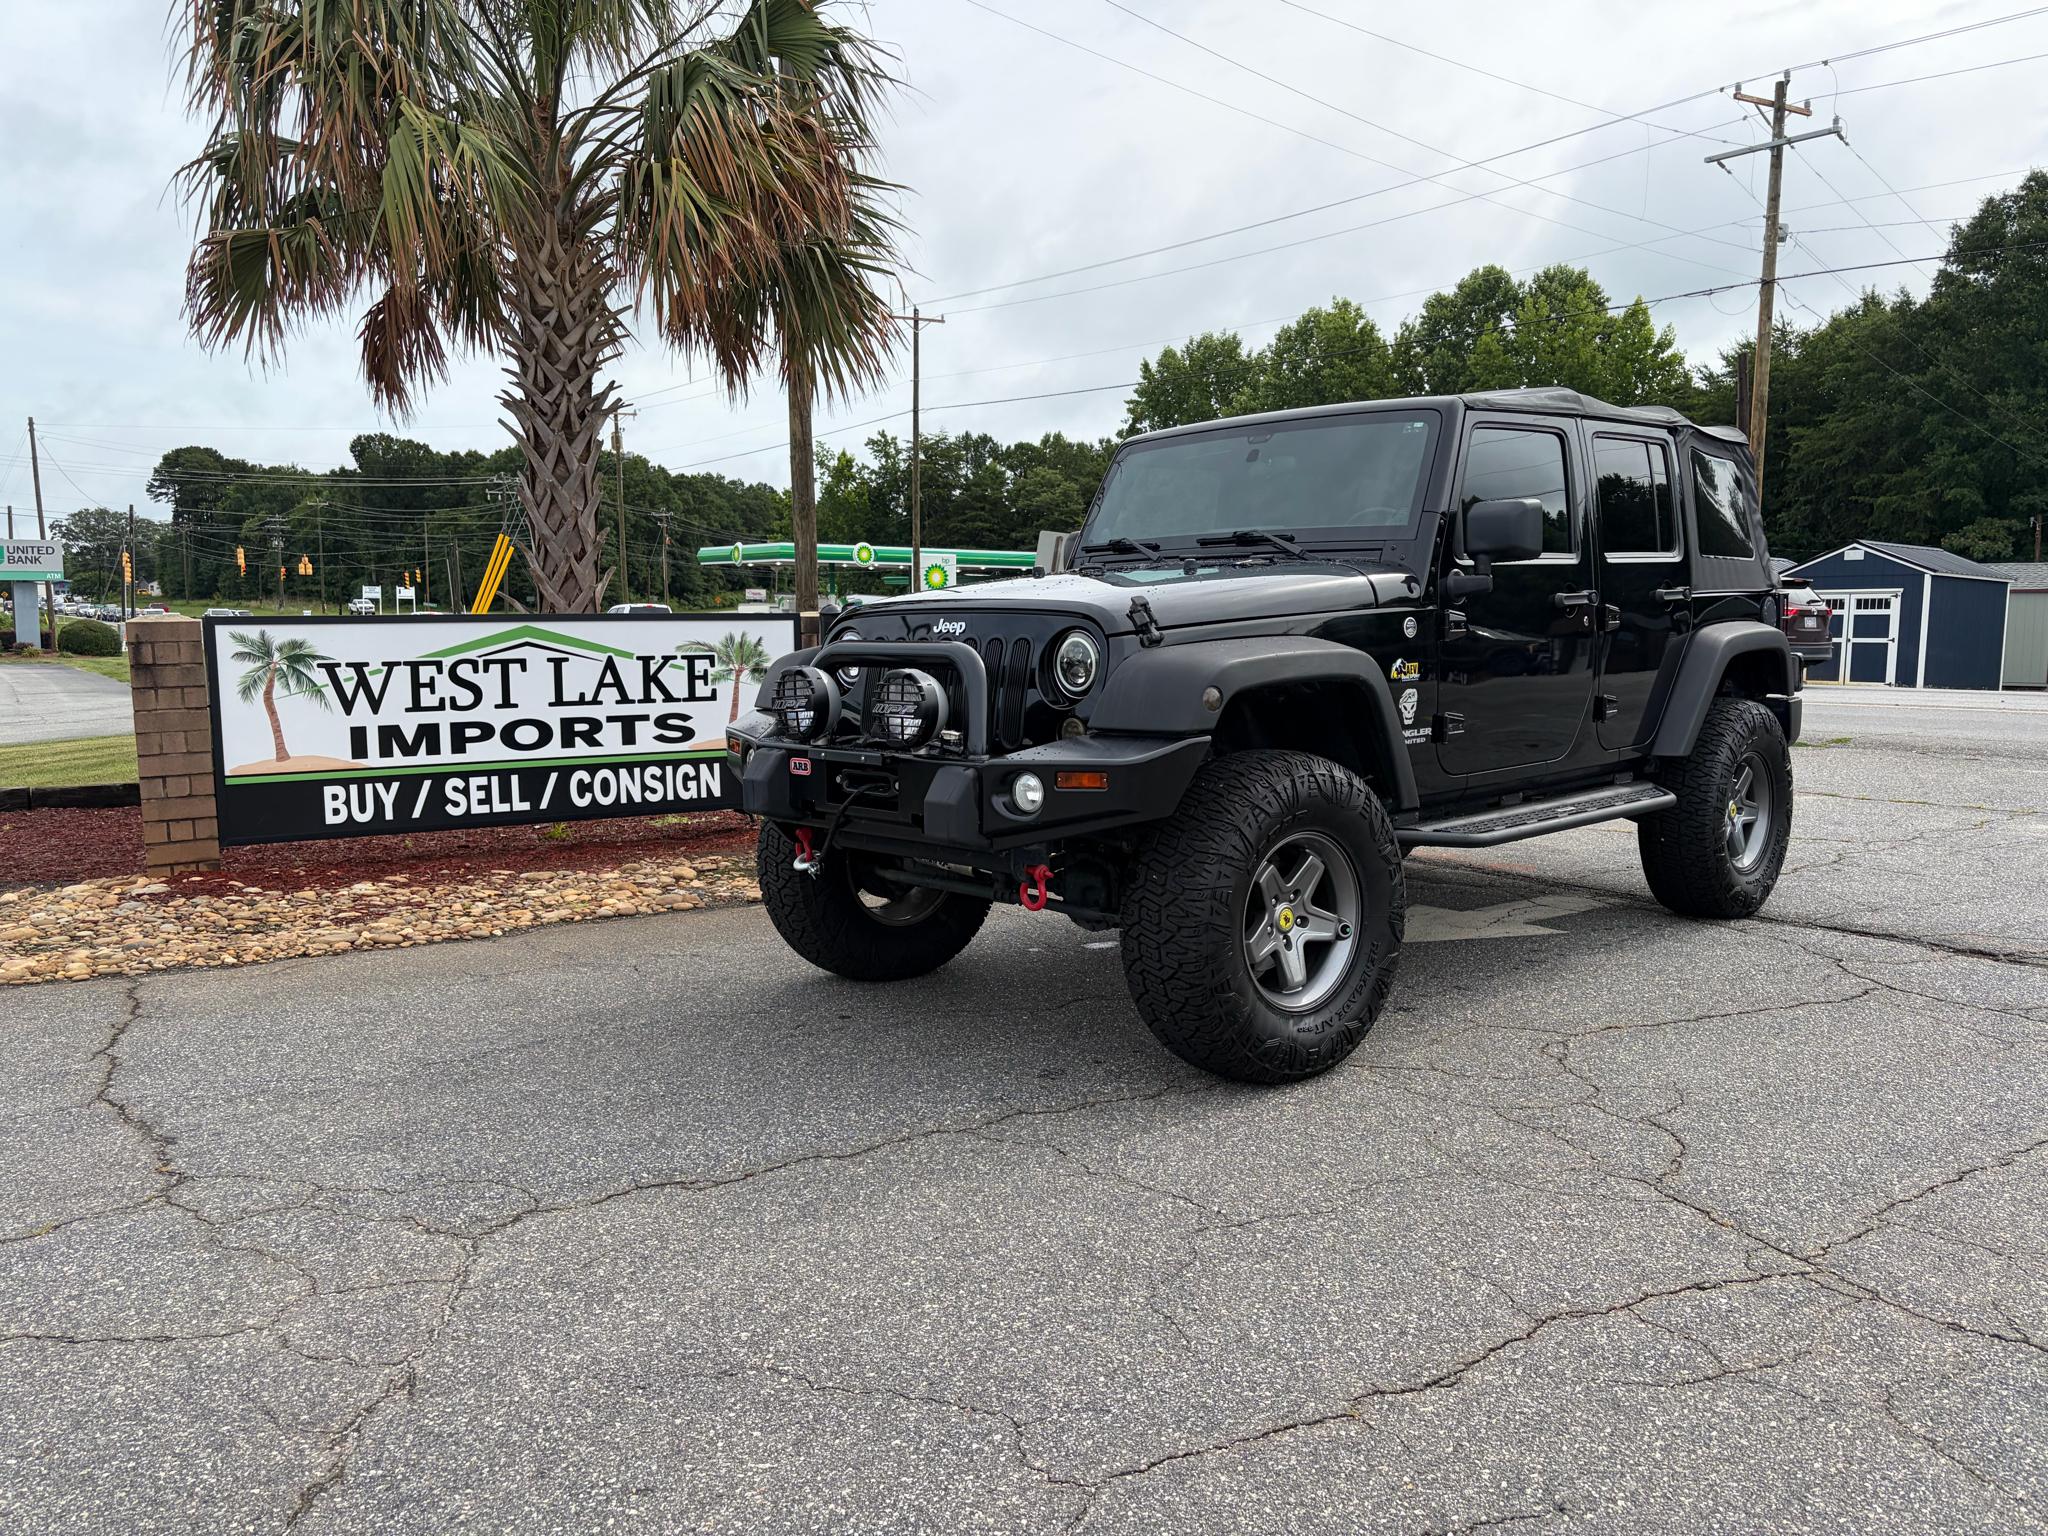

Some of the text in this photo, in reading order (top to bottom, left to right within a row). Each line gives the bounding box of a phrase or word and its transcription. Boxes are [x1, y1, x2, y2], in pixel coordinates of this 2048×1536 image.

[6, 545, 55, 555] UNITED
[7, 555, 42, 565] BANK
[941, 556, 950, 565] bp
[933, 618, 966, 636] Jeep
[316, 654, 718, 717] WEST LAKE
[349, 712, 696, 760] IMPORTS
[1402, 727, 1432, 738] NGLER
[792, 761, 809, 771] ARB
[323, 762, 722, 825] BUY / SELL / CONSIGN
